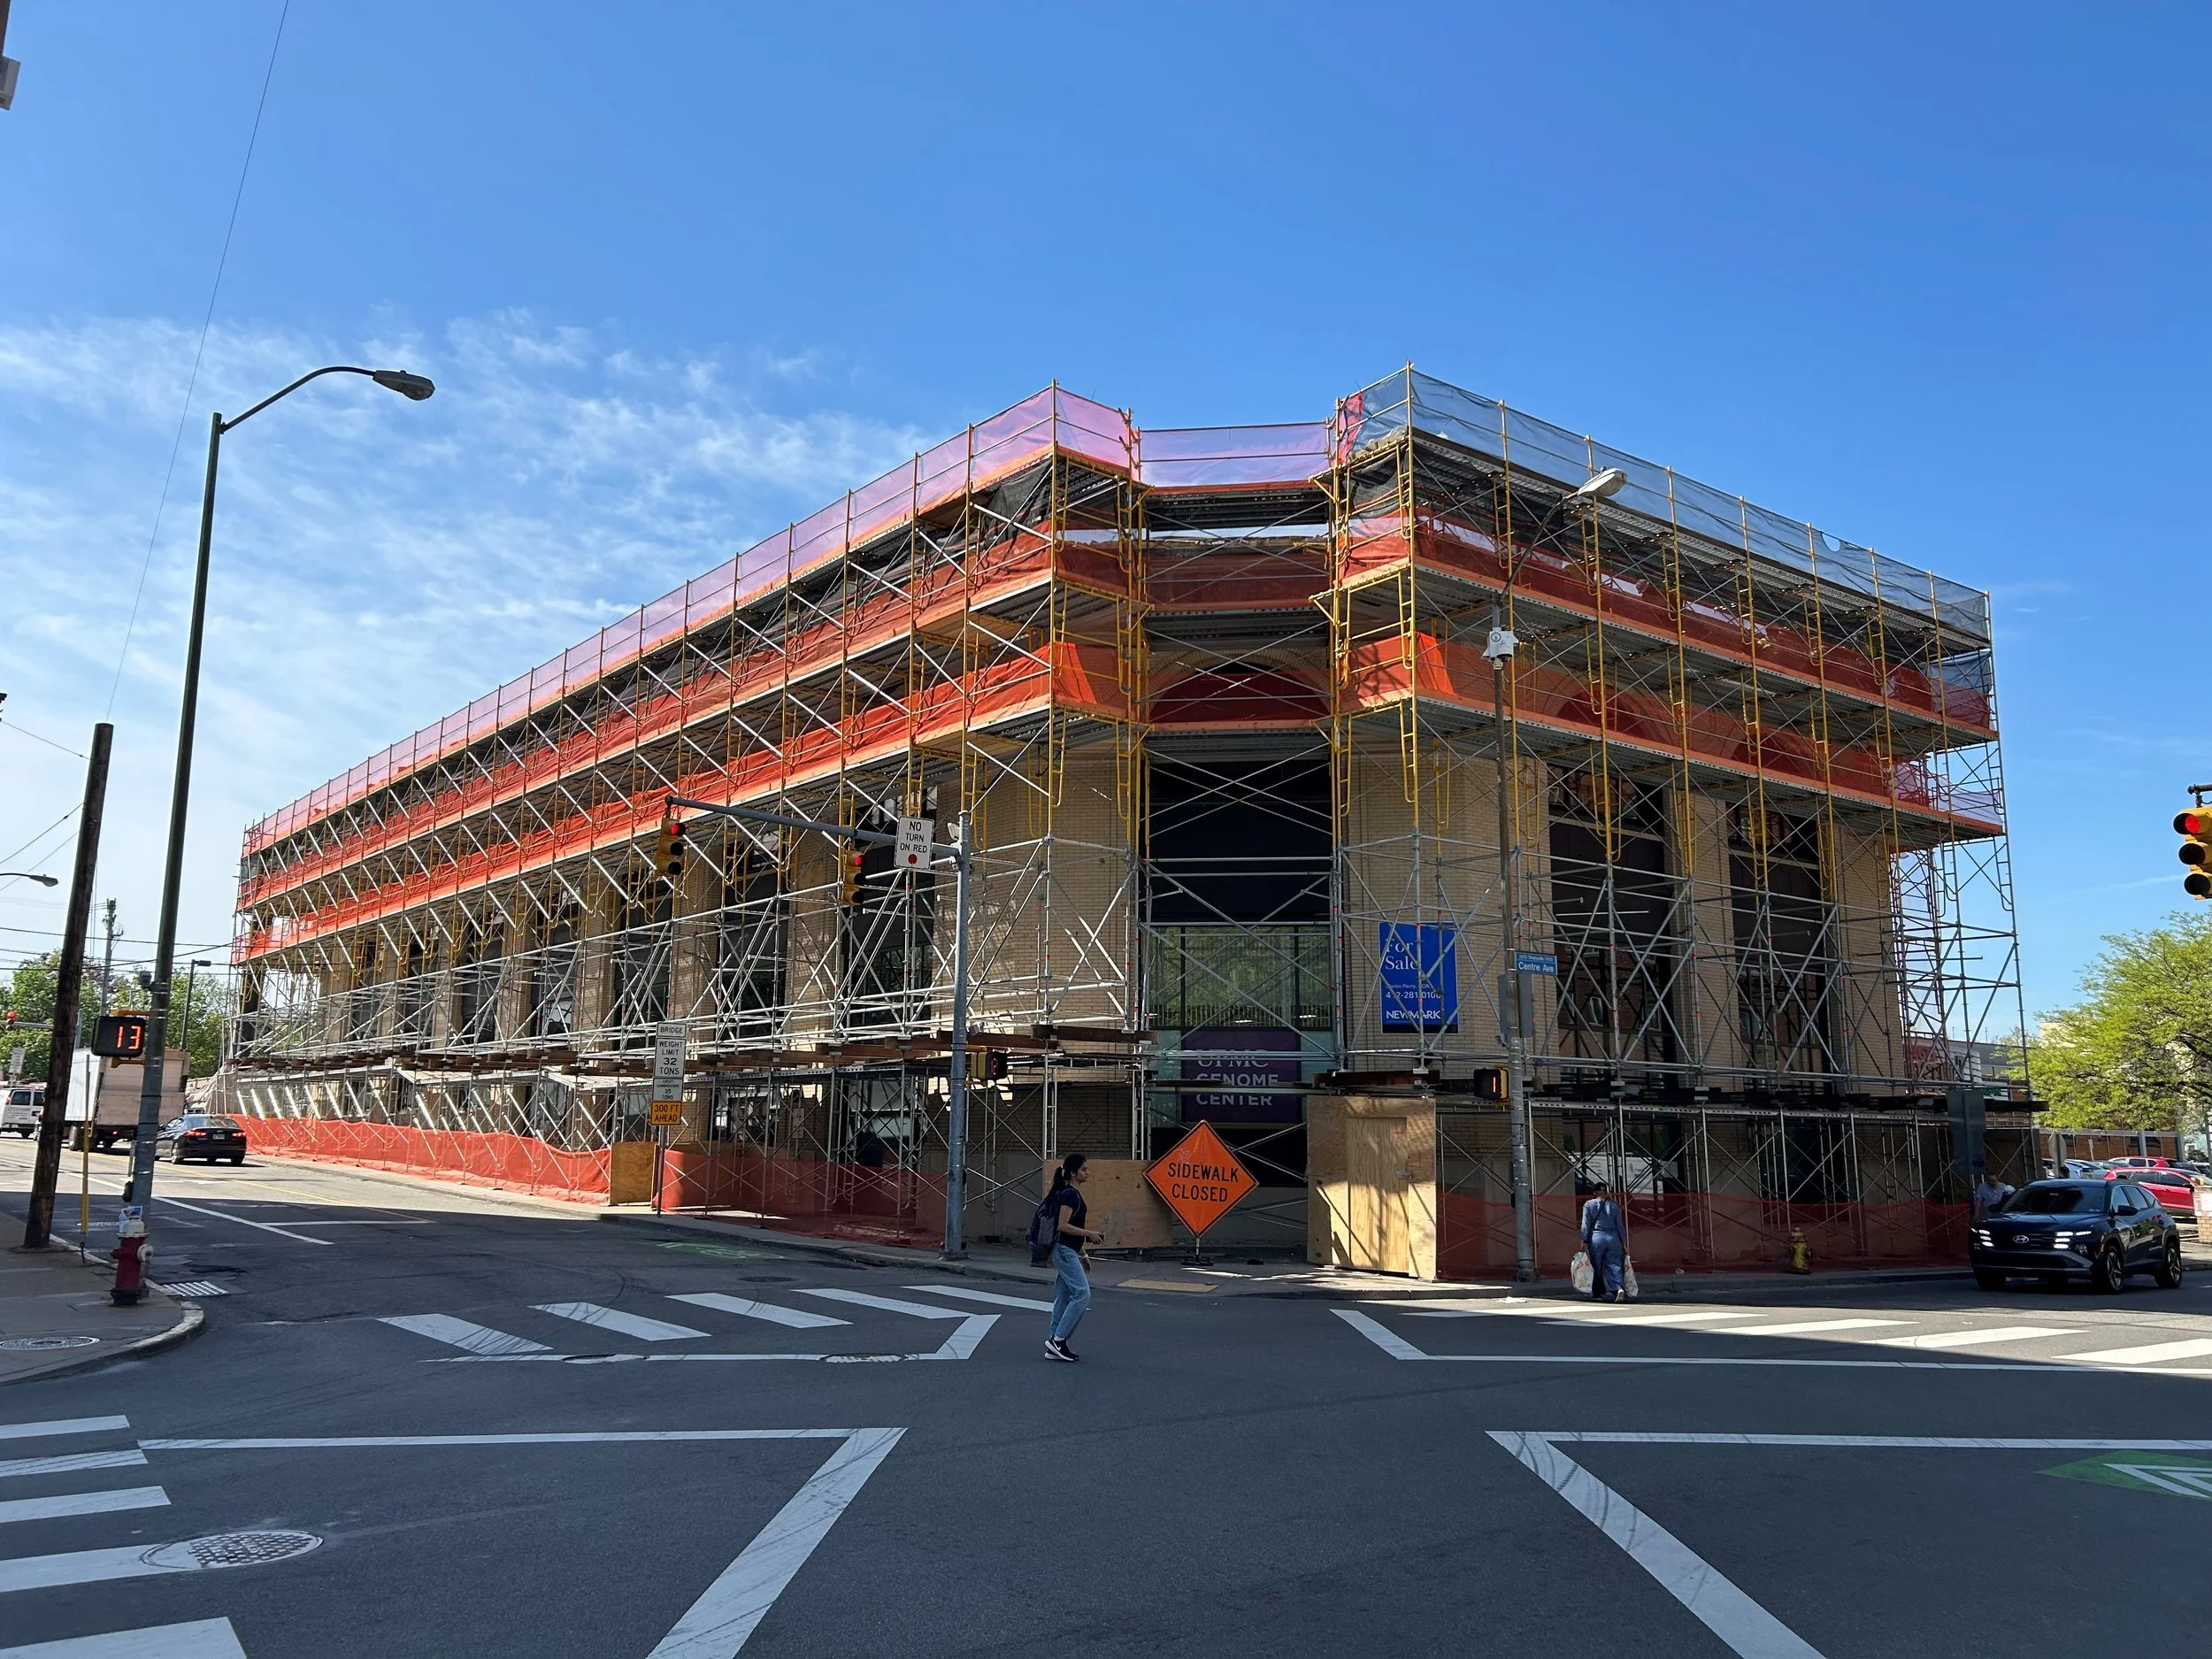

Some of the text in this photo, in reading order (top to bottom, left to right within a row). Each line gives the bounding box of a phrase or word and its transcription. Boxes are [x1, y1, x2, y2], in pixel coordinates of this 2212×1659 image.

[909, 821, 922, 832] NO
[905, 833, 925, 842] TURN
[900, 842, 928, 854] ON RED
[1385, 938, 1414, 953] For
[1385, 955, 1417, 971] Sale
[1518, 961, 1555, 973] Centre Ave
[1386, 1010, 1441, 1019] NEWMARK
[117, 1025, 142, 1050] 13
[659, 1067, 680, 1076] TONS
[1195, 1094, 1272, 1106] CENTER
[655, 1114, 678, 1123] AHEAD
[1167, 1162, 1239, 1183] SIDEWALK
[1171, 1183, 1228, 1202] CLOSED
